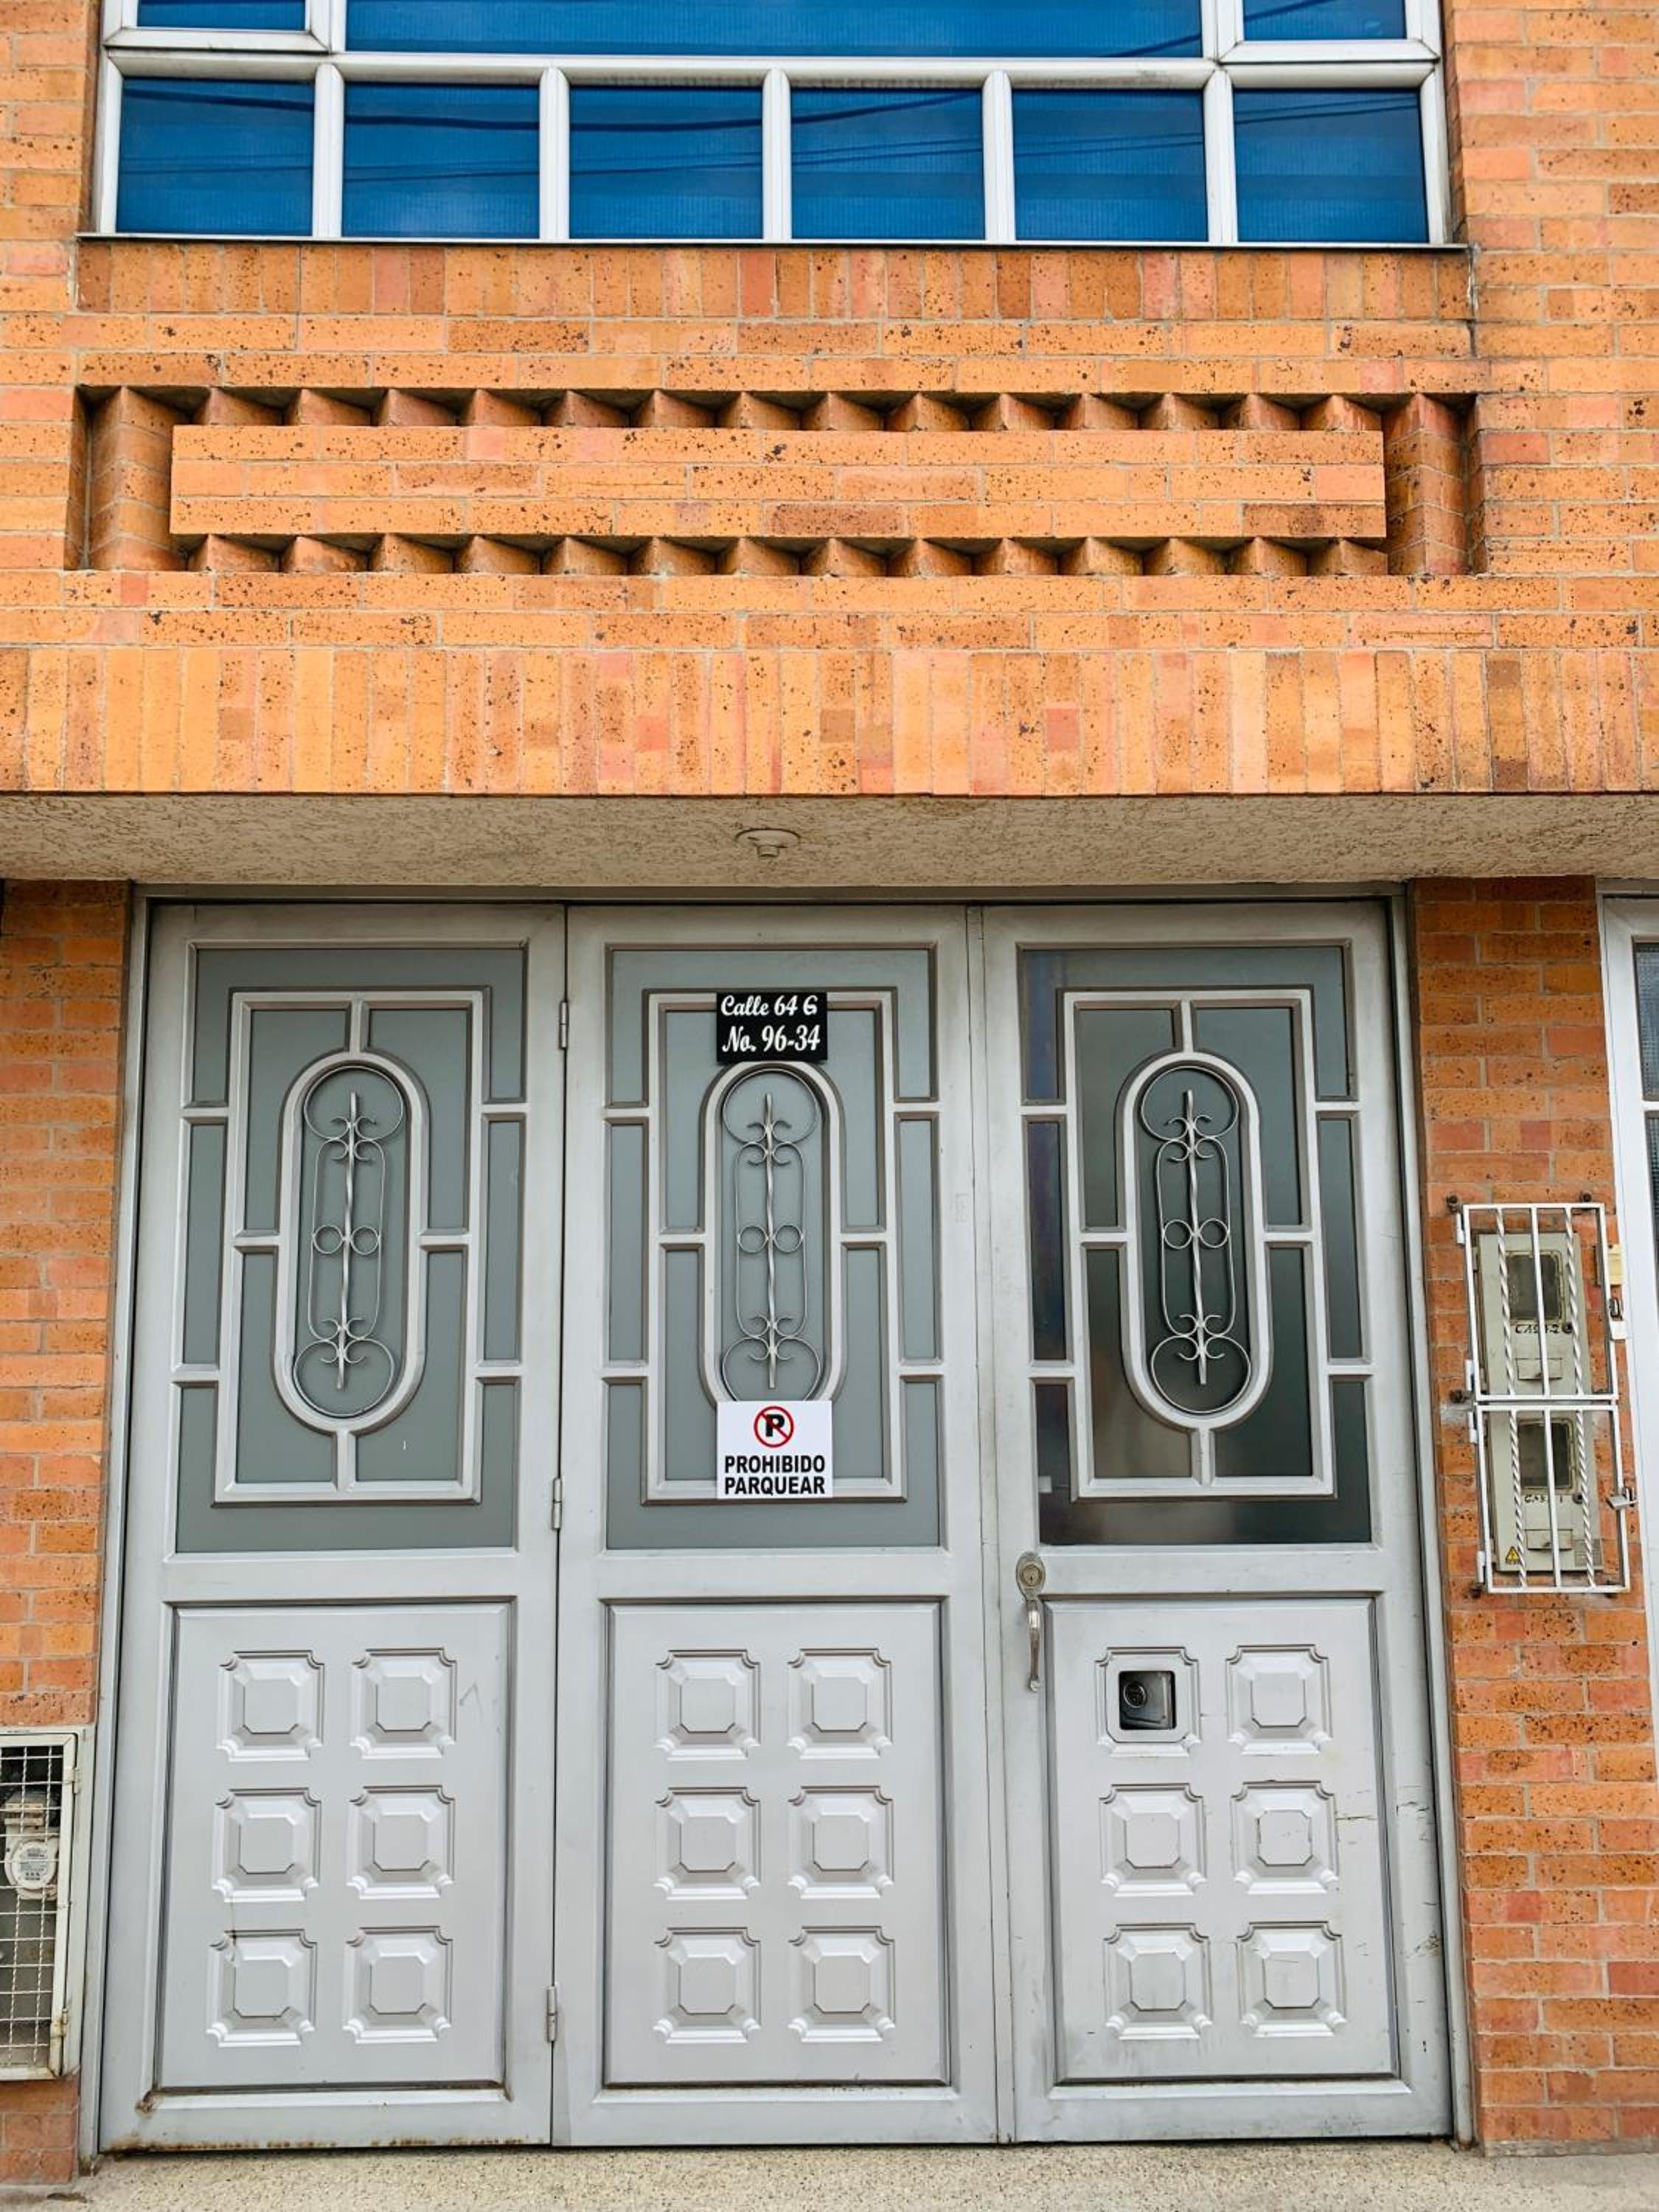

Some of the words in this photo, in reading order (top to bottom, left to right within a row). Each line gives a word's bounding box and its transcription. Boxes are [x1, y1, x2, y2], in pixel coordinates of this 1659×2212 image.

[721, 995, 769, 1016] Calle
[774, 995, 798, 1016] 64
[803, 995, 818, 1015] G
[722, 1026, 757, 1052] No.
[762, 1025, 820, 1051] 96-34
[725, 1455, 825, 1473] PROHIBIDO
[725, 1476, 825, 1495] PARQUEAR
